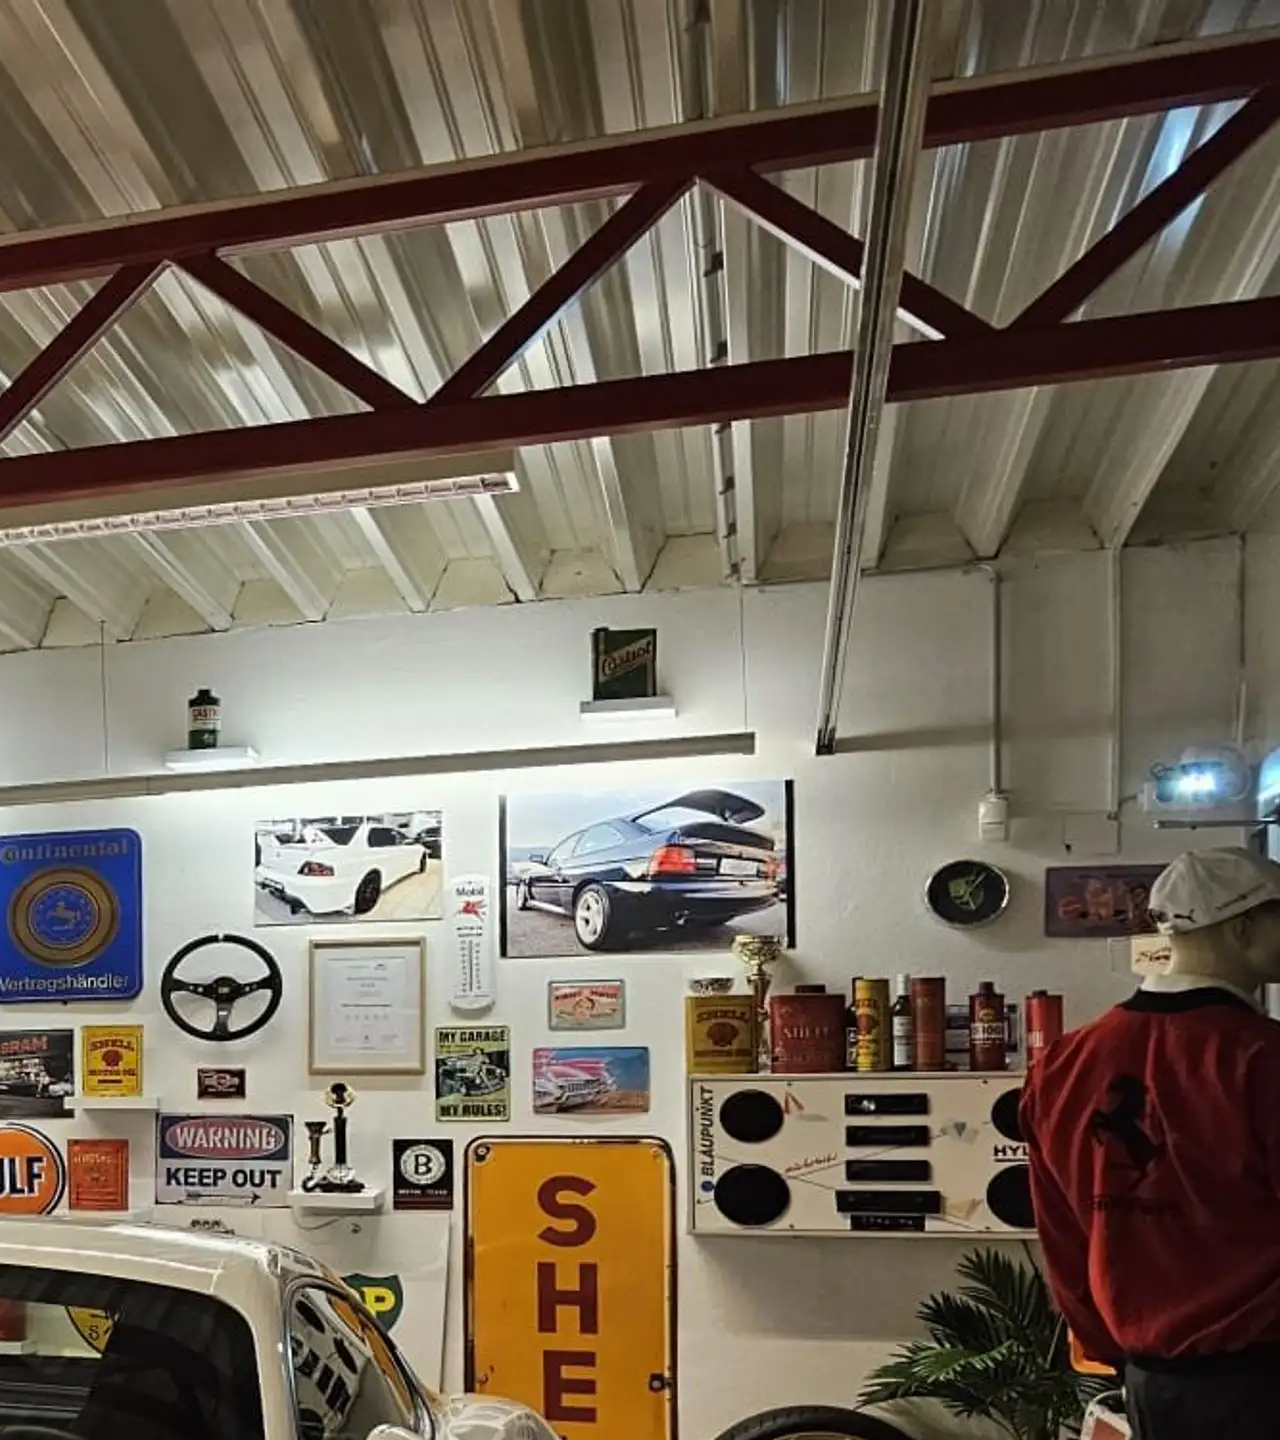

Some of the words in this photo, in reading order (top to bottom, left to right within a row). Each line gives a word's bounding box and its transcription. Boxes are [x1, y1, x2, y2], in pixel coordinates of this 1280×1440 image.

[0, 836, 130, 864] Continental
[460, 1029, 507, 1042] GARAGE
[176, 1126, 277, 1150] WARNING
[700, 1086, 715, 1177] BLAUPUNKT
[166, 1167, 227, 1188] KEEP
[232, 1168, 282, 1189] OUT
[361, 1286, 396, 1319] P
[537, 1174, 598, 1423] SHE
